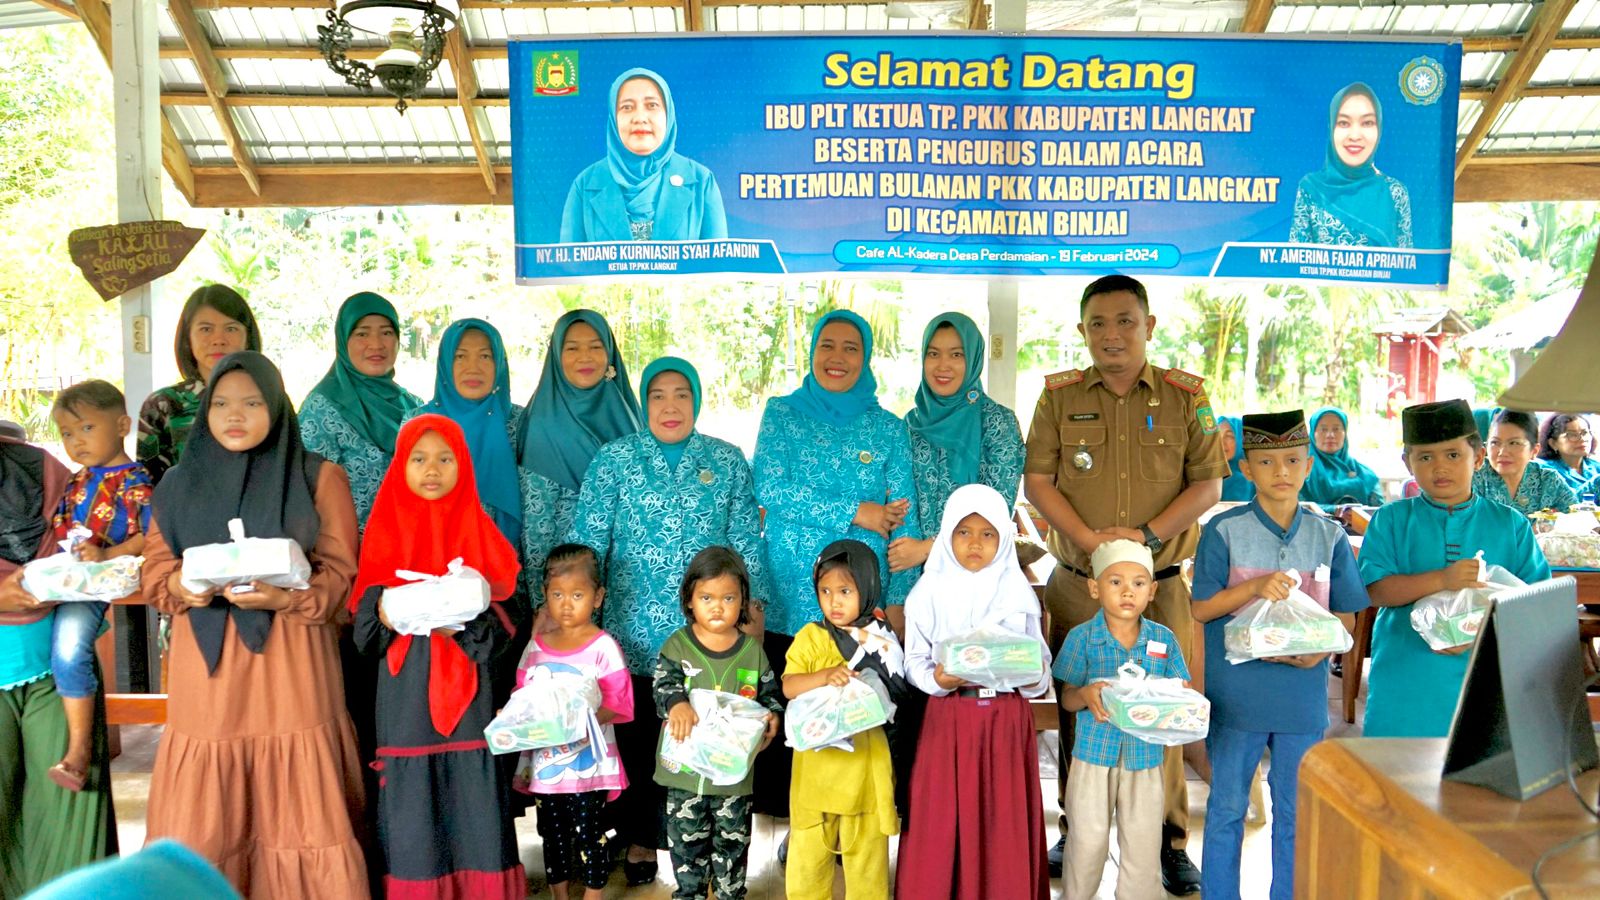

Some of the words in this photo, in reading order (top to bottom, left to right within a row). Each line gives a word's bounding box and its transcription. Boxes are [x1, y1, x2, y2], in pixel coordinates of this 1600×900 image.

[825, 53, 1010, 88] Selamat
[1022, 55, 1195, 100] Datang
[765, 104, 804, 129] IBU
[811, 104, 847, 129] PLT
[852, 104, 924, 129] KETUA
[928, 105, 957, 130] TP.
[963, 106, 1008, 130] PKK
[1014, 106, 1146, 132] KABUPATEN
[1151, 106, 1255, 133] LANGKAT
[814, 137, 913, 164] BESERTA
[917, 138, 1036, 166] PENGURUS
[1041, 141, 1120, 167] DALAM
[1125, 140, 1204, 167] ACARA
[740, 172, 874, 199] PERTEMUAN
[879, 172, 981, 200] BULANAN
[986, 175, 1033, 201] PKK
[1037, 175, 1171, 202] KABUPATEN
[1176, 176, 1280, 203] LANGKAT
[887, 207, 911, 232] DI
[916, 208, 1048, 236] KECAMATAN
[1053, 210, 1128, 236] BINJAI
[93, 255, 136, 274] Saling
[137, 252, 172, 269] Setia
[536, 249, 553, 264] NY.
[555, 248, 571, 263] HJ.
[573, 246, 617, 262] ENDANG
[619, 245, 680, 261] KURNIASIH
[681, 244, 711, 260] SYAH
[712, 243, 760, 259] AFANDIN
[856, 246, 884, 258] Cafe
[887, 246, 947, 261] AL-Kadera
[949, 248, 979, 261] Desa
[980, 248, 1049, 262] Perdamaian
[1059, 249, 1071, 262] 19
[1073, 249, 1123, 262] Februari
[1125, 248, 1159, 261] 2024
[1260, 249, 1278, 264] NY.
[1281, 249, 1328, 265] AMERINA
[1332, 252, 1364, 267] FAJAR
[1366, 253, 1417, 270] APRIANTA
[608, 263, 628, 271] KETUA
[651, 262, 678, 271] LANGKAT
[1300, 266, 1318, 275] KETUA
[1339, 268, 1373, 278] KECAMATAN
[1373, 269, 1391, 279] BINJAI
